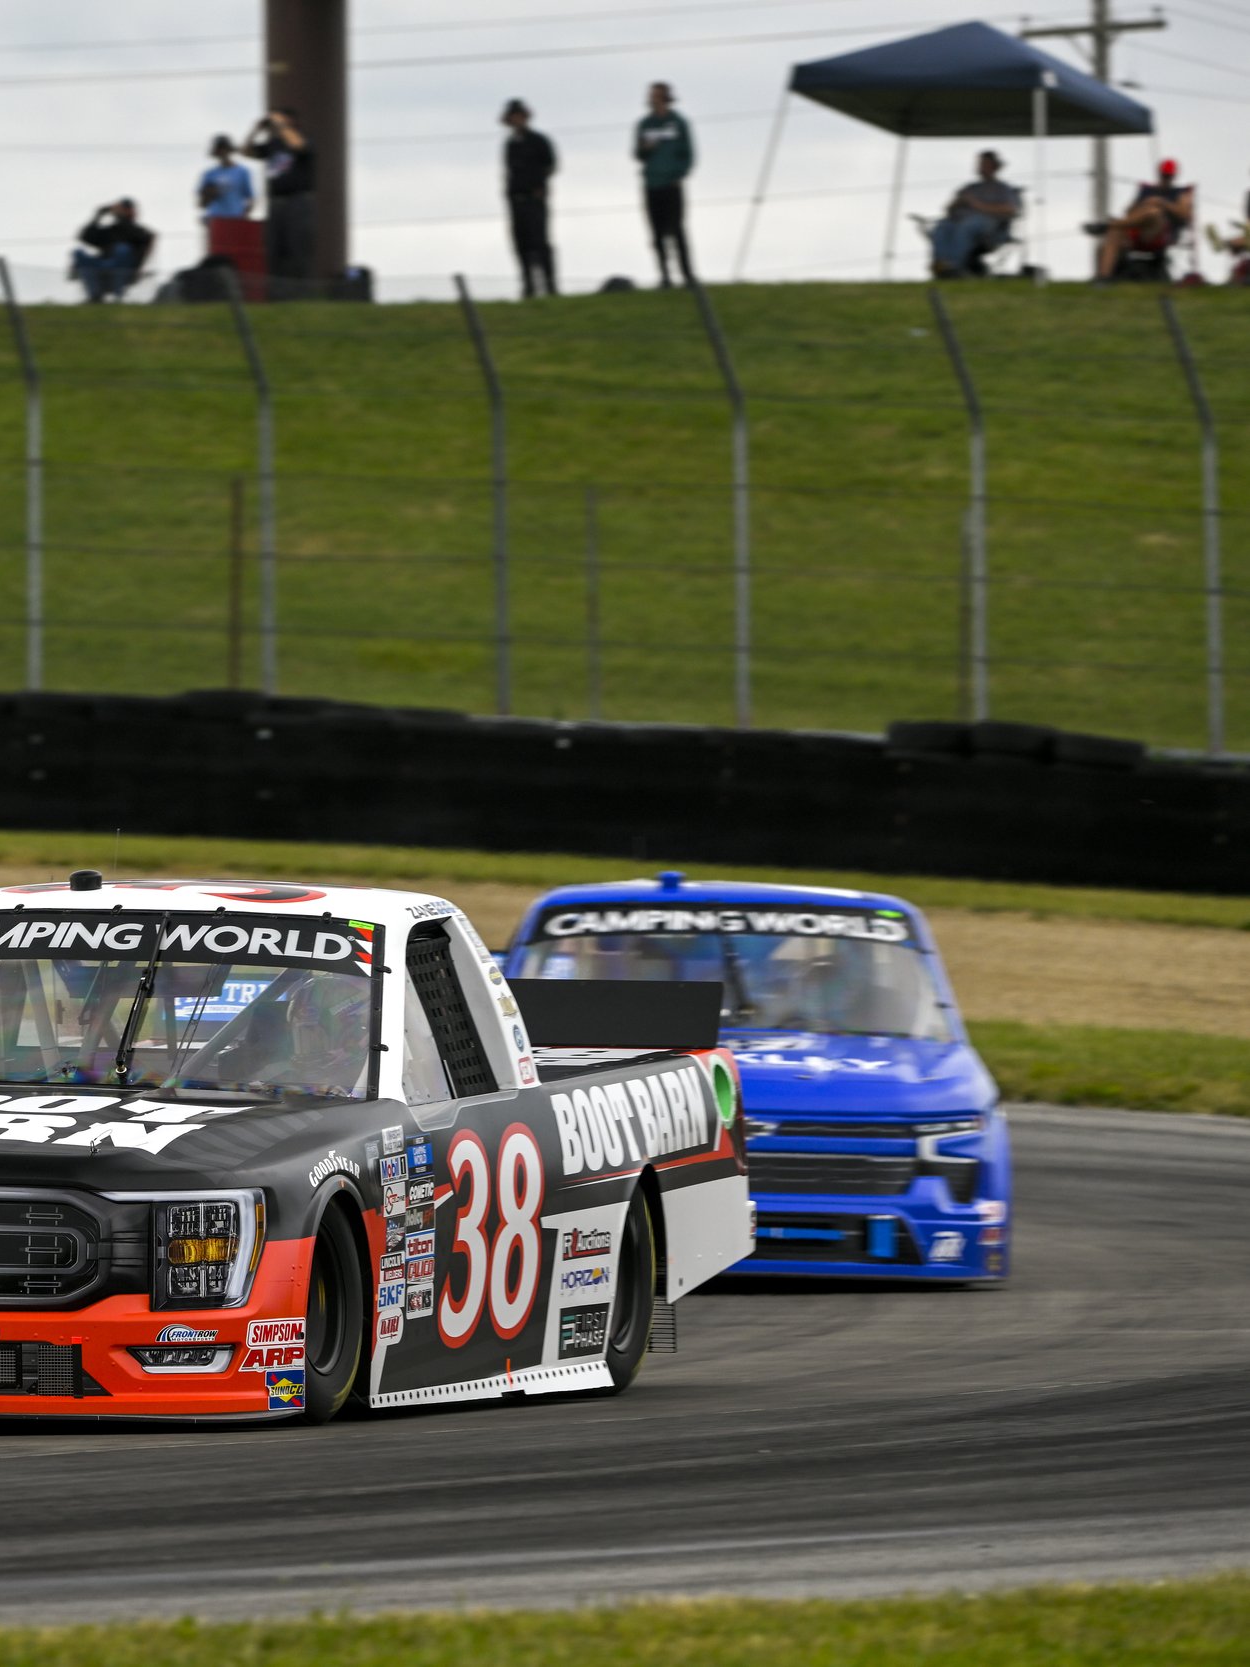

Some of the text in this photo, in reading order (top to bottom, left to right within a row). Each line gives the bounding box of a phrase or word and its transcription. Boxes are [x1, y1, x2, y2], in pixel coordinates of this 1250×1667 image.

[405, 903, 439, 919] ZANE
[544, 910, 909, 942] CAMPING WORLD
[155, 924, 354, 961] WORLD
[550, 1066, 709, 1176] BOOT BARN
[309, 1152, 361, 1188] GOODYEAR
[381, 1157, 400, 1178] Mobil
[438, 1122, 545, 1349] 38
[407, 1237, 433, 1257] tilton
[381, 1253, 402, 1270] LINCOLN
[407, 1259, 435, 1280] CALICO
[379, 1283, 405, 1308] SKF
[575, 1311, 607, 1332] FIRST
[251, 1322, 303, 1343] SIMPSON
[574, 1329, 605, 1349] PHASE
[242, 1346, 305, 1367] ARP
[270, 1384, 304, 1397] SUNOCO
